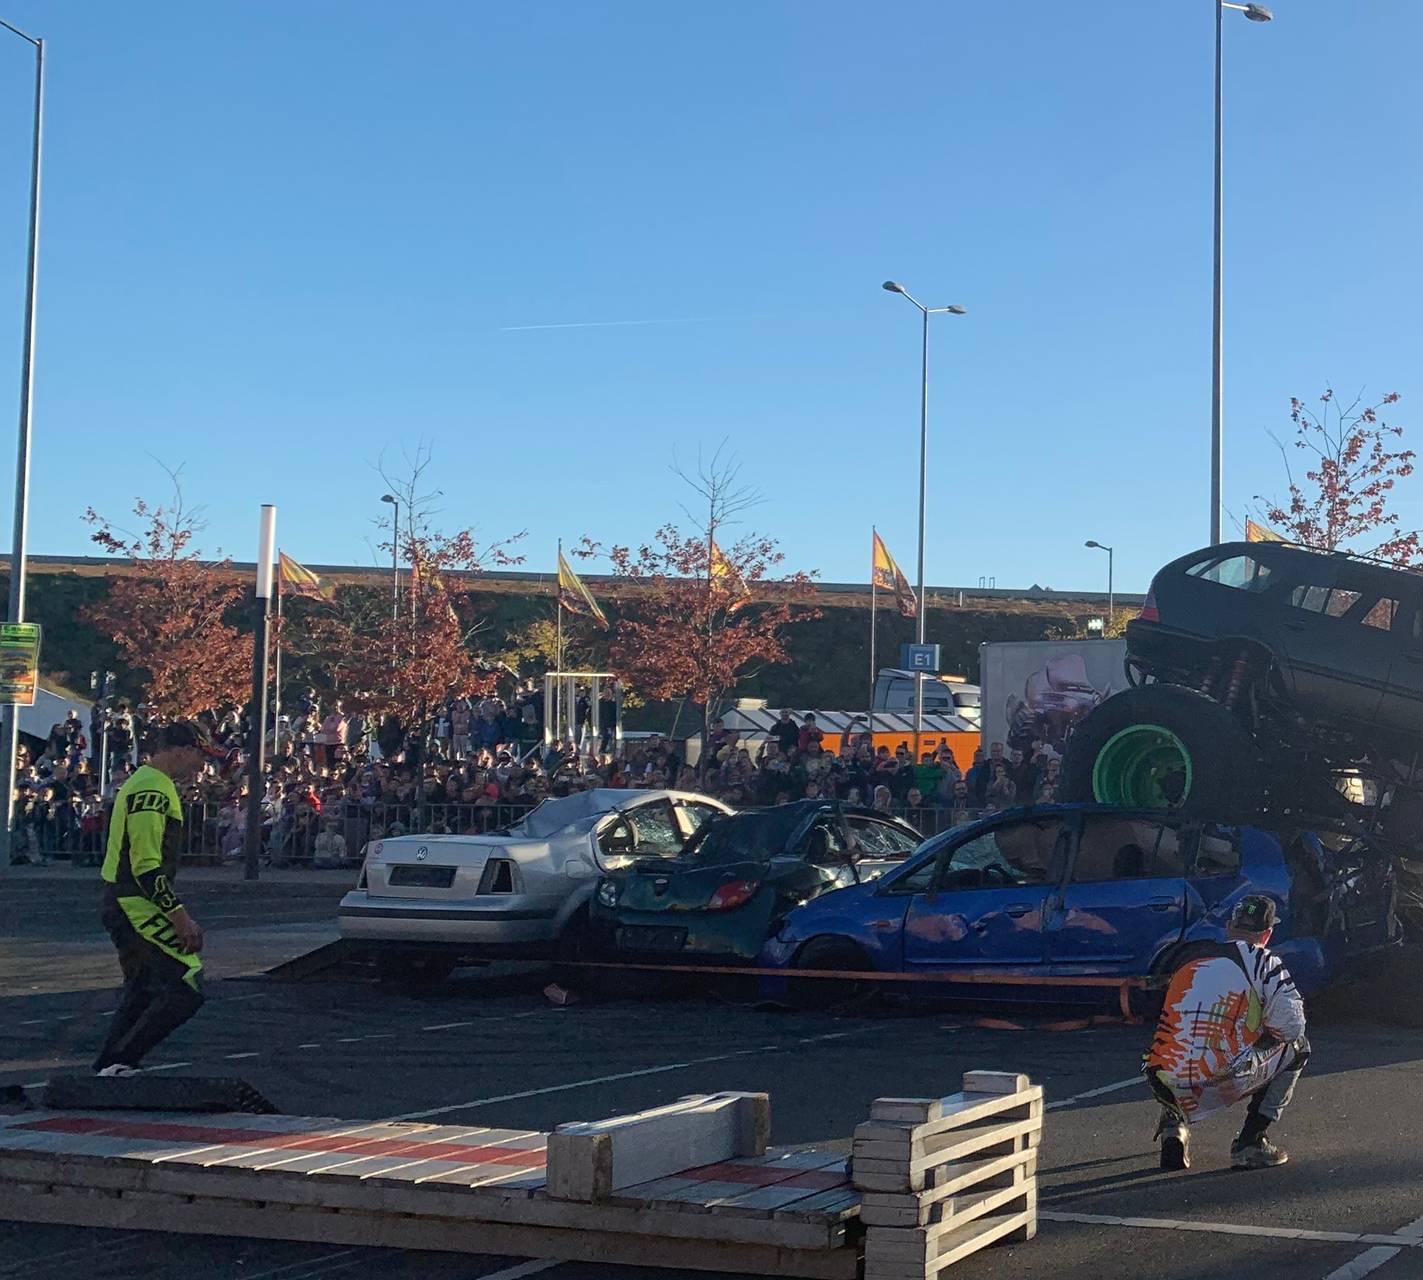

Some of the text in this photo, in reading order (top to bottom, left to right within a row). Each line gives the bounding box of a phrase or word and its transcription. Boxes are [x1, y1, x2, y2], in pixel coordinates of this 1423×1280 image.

[914, 653, 930, 666] E1
[130, 791, 170, 814] FOX
[138, 913, 187, 954] FO
